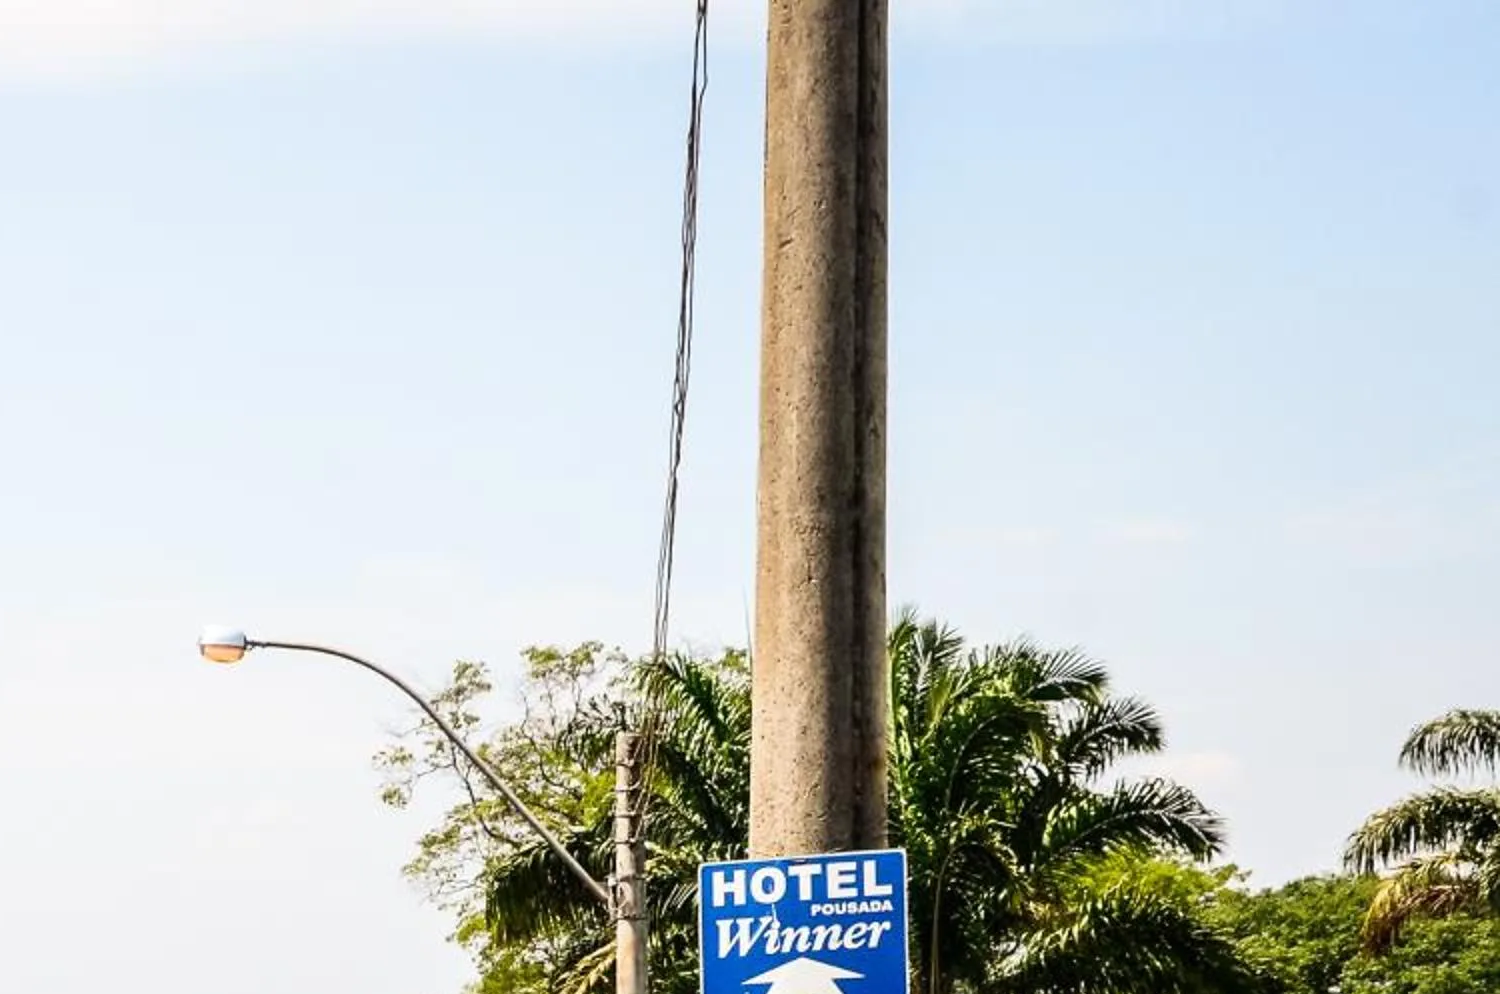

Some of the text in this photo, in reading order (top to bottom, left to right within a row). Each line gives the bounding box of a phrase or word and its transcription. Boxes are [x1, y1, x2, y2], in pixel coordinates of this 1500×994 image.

[711, 860, 893, 907] HOTEL
[810, 900, 893, 917] POUSADA
[715, 915, 891, 959] Winner
